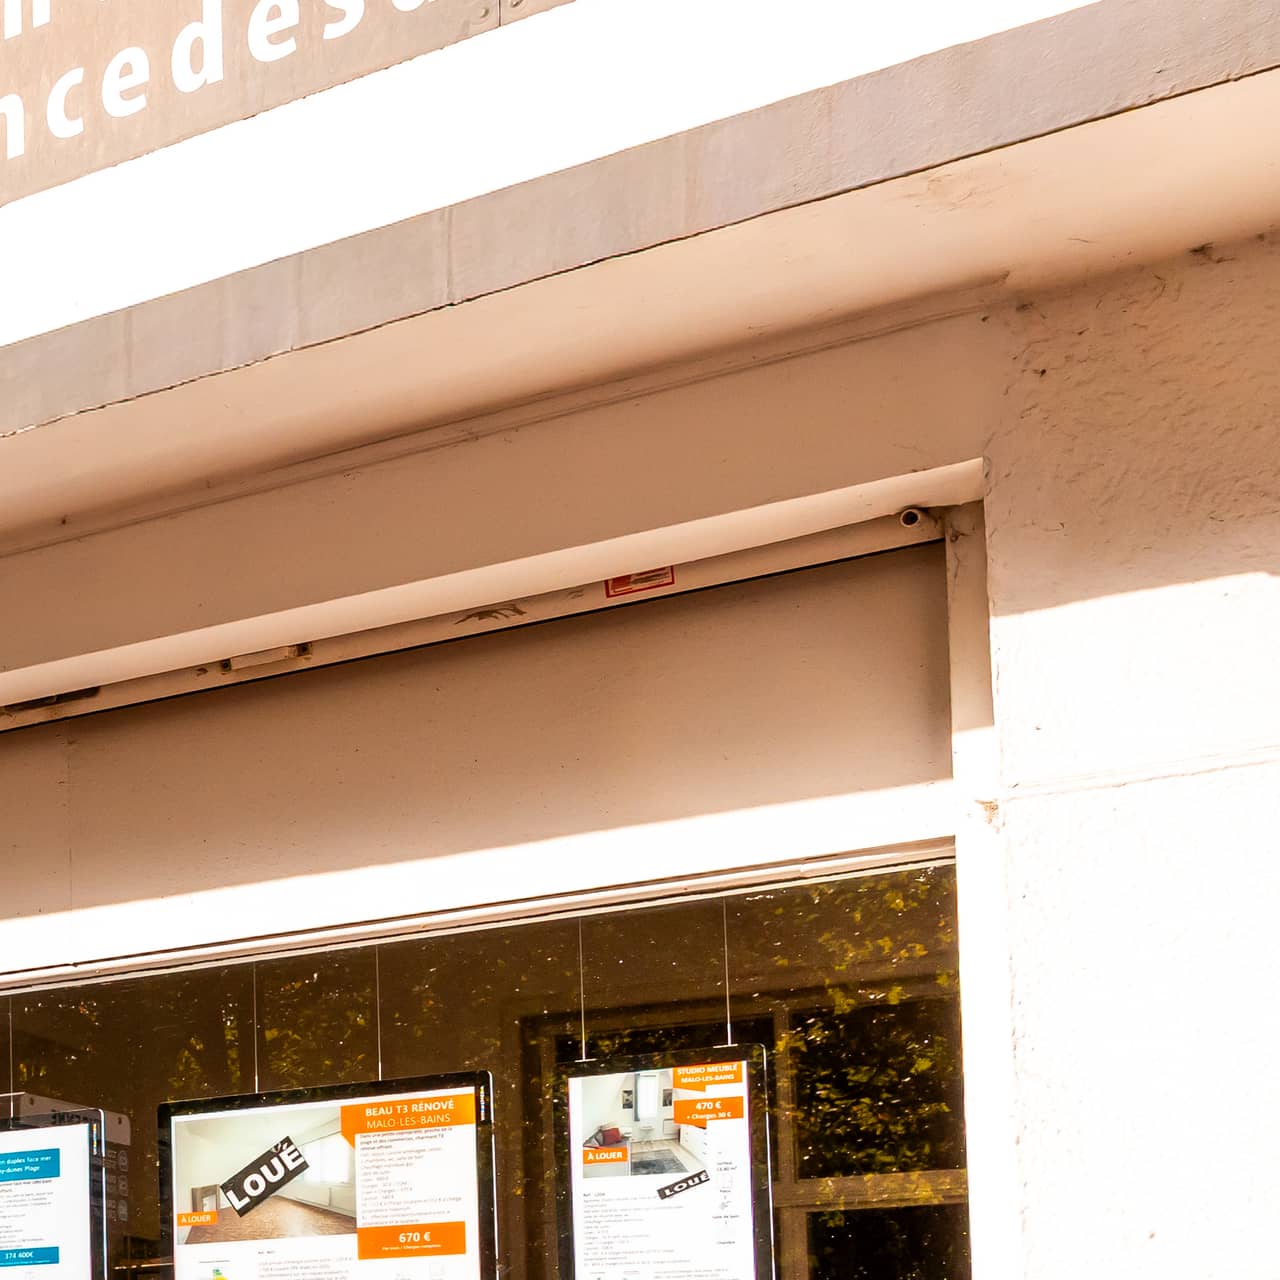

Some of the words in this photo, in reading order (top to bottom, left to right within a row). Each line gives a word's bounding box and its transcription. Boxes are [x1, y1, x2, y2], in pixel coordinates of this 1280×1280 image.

[365, 1106, 393, 1117] BEAU
[396, 1105, 408, 1114] T3
[411, 1098, 454, 1113] RÉNOVÉ
[696, 1102, 713, 1110] 470
[366, 1113, 451, 1129] MALO-LES-BAINS
[595, 1151, 623, 1160] LOUER
[226, 1142, 305, 1210] LOUÉ
[399, 1232, 421, 1243] 670
[423, 1231, 431, 1241] €
